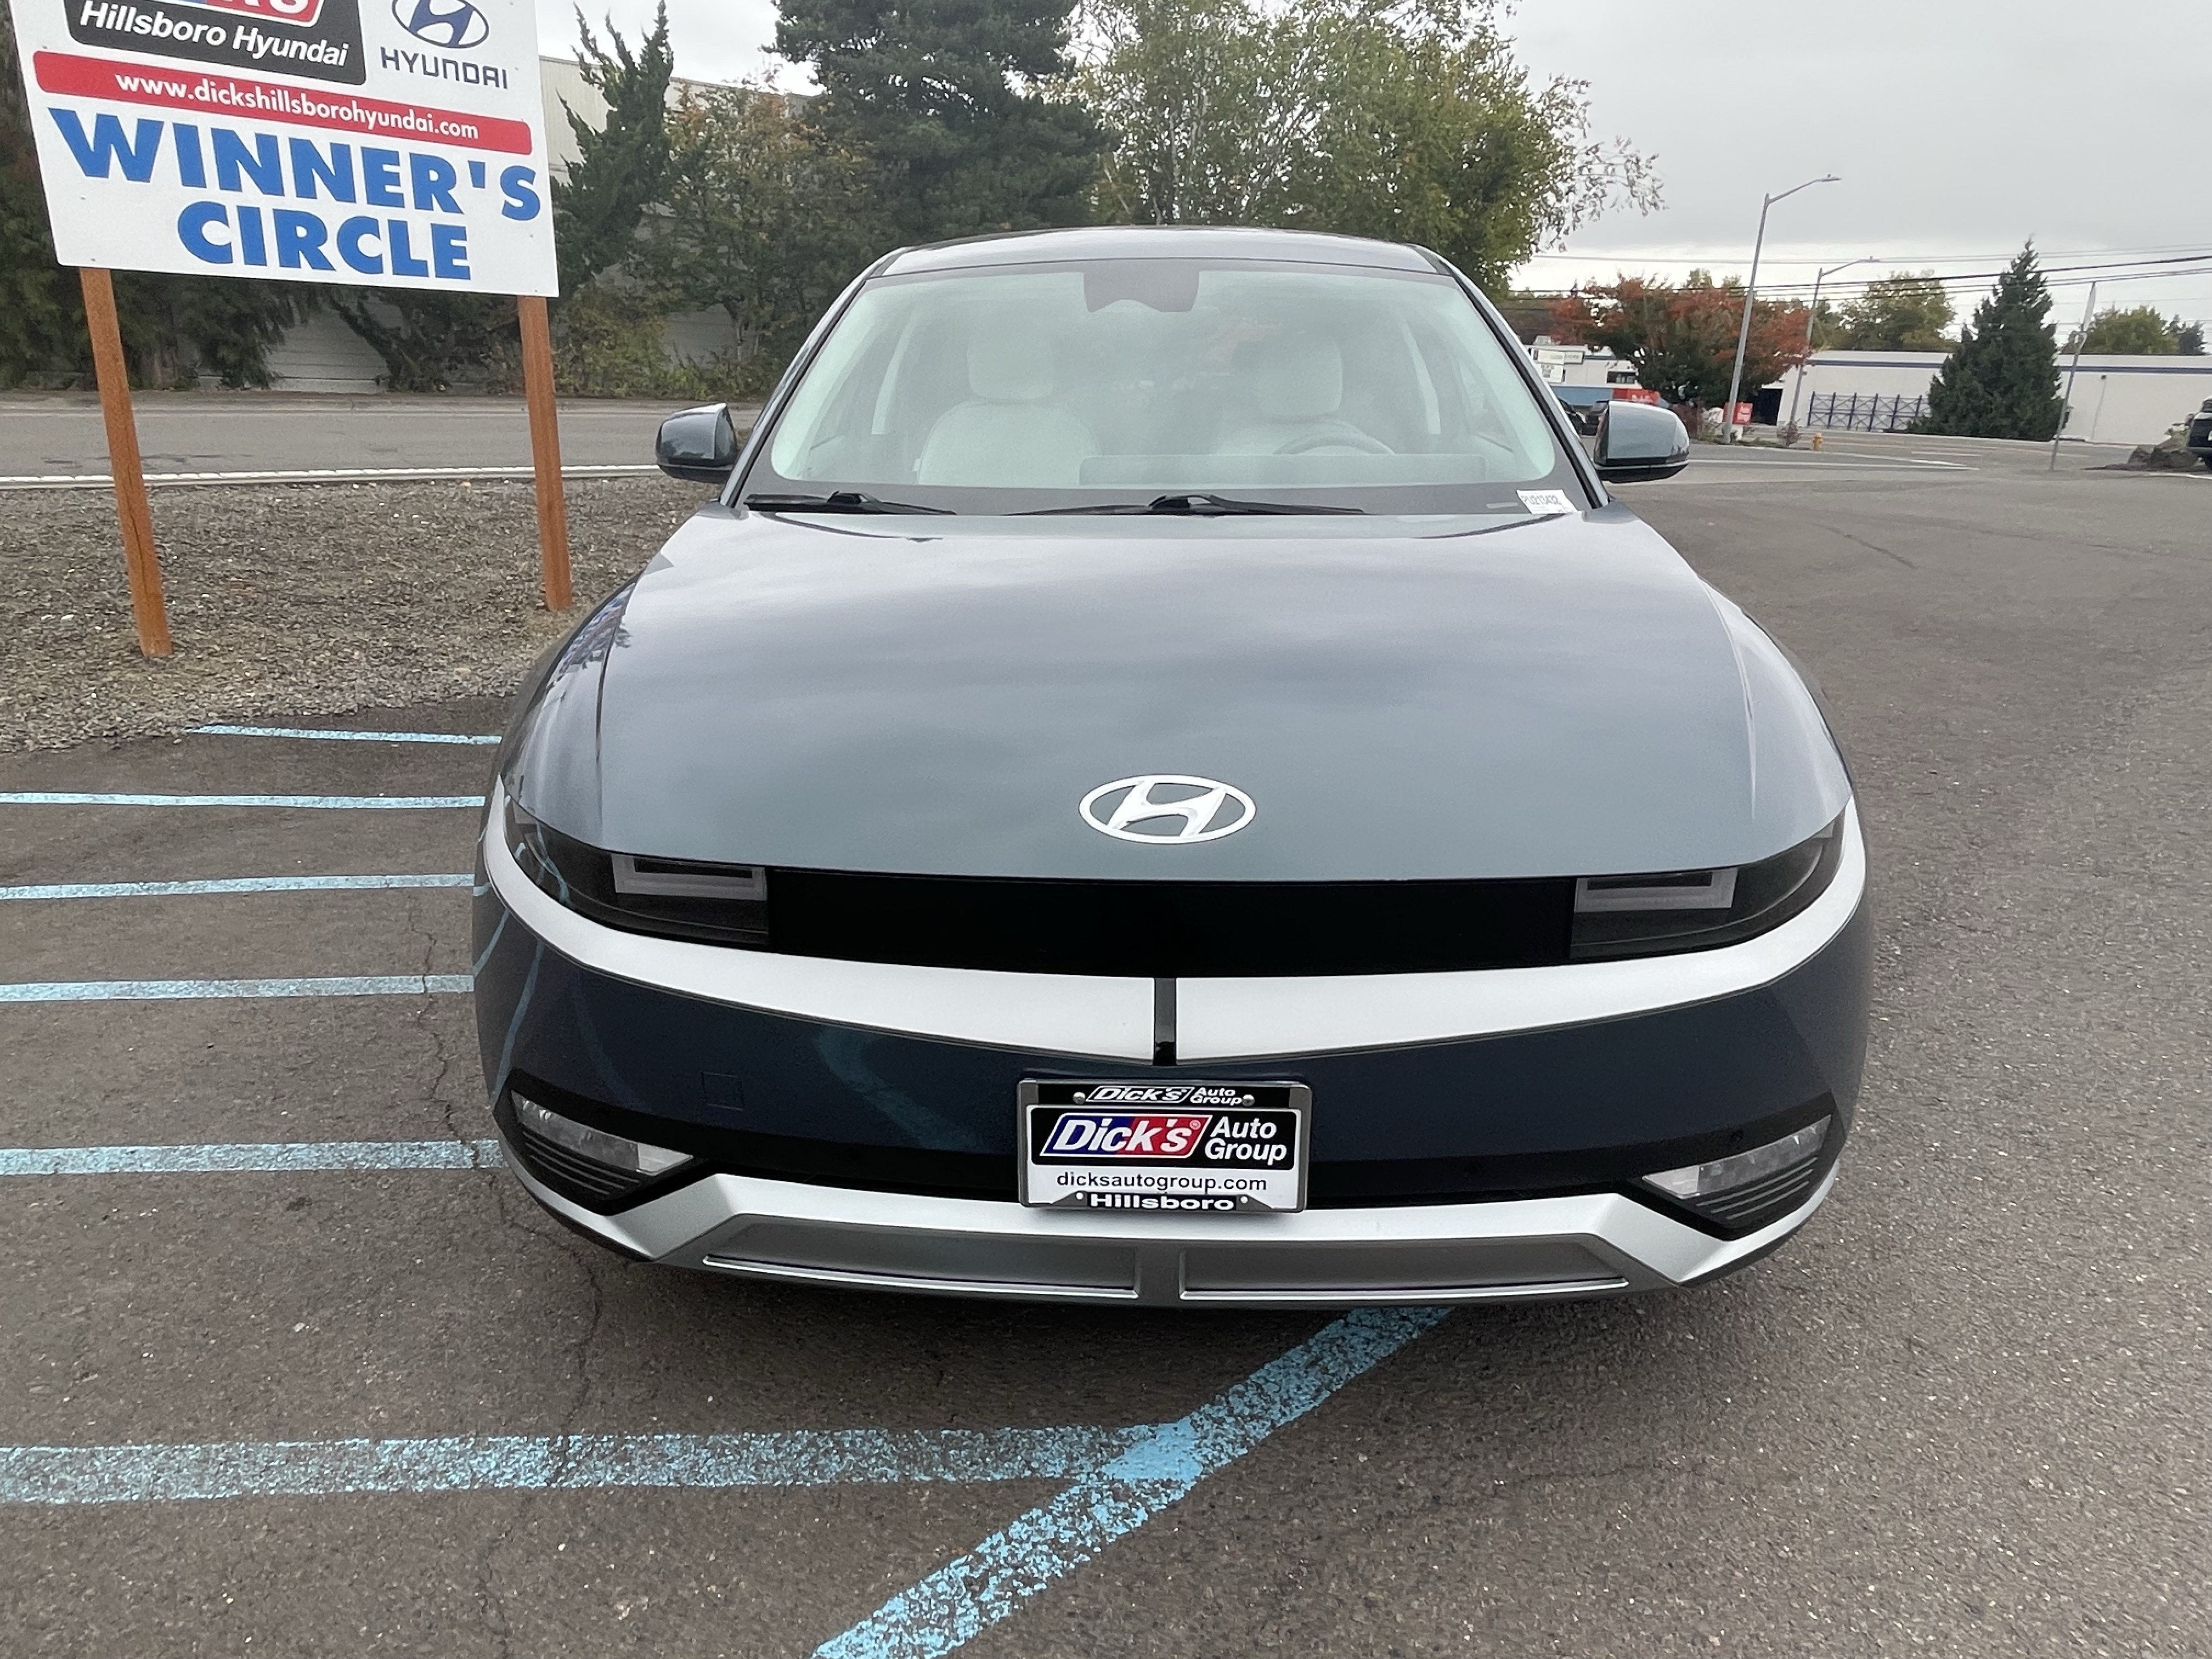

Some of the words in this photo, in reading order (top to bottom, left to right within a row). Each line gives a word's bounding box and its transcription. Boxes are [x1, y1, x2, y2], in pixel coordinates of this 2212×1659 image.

[80, 0, 227, 46] Hillsboro
[233, 25, 349, 66] Hyundai
[381, 46, 508, 89] HYUNDAI
[115, 74, 478, 140] www.dickshillsborohyundai.com
[48, 107, 540, 221] WINNER'S
[177, 201, 471, 280] CIRCLE
[1190, 1096, 1242, 1105] Group
[1194, 1087, 1235, 1097] Auto
[1210, 1116, 1277, 1139] Auto
[1205, 1138, 1287, 1165] Group
[1057, 1172, 1267, 1194] dicksautogroup.com
[1090, 1193, 1234, 1210] Hillsboro
